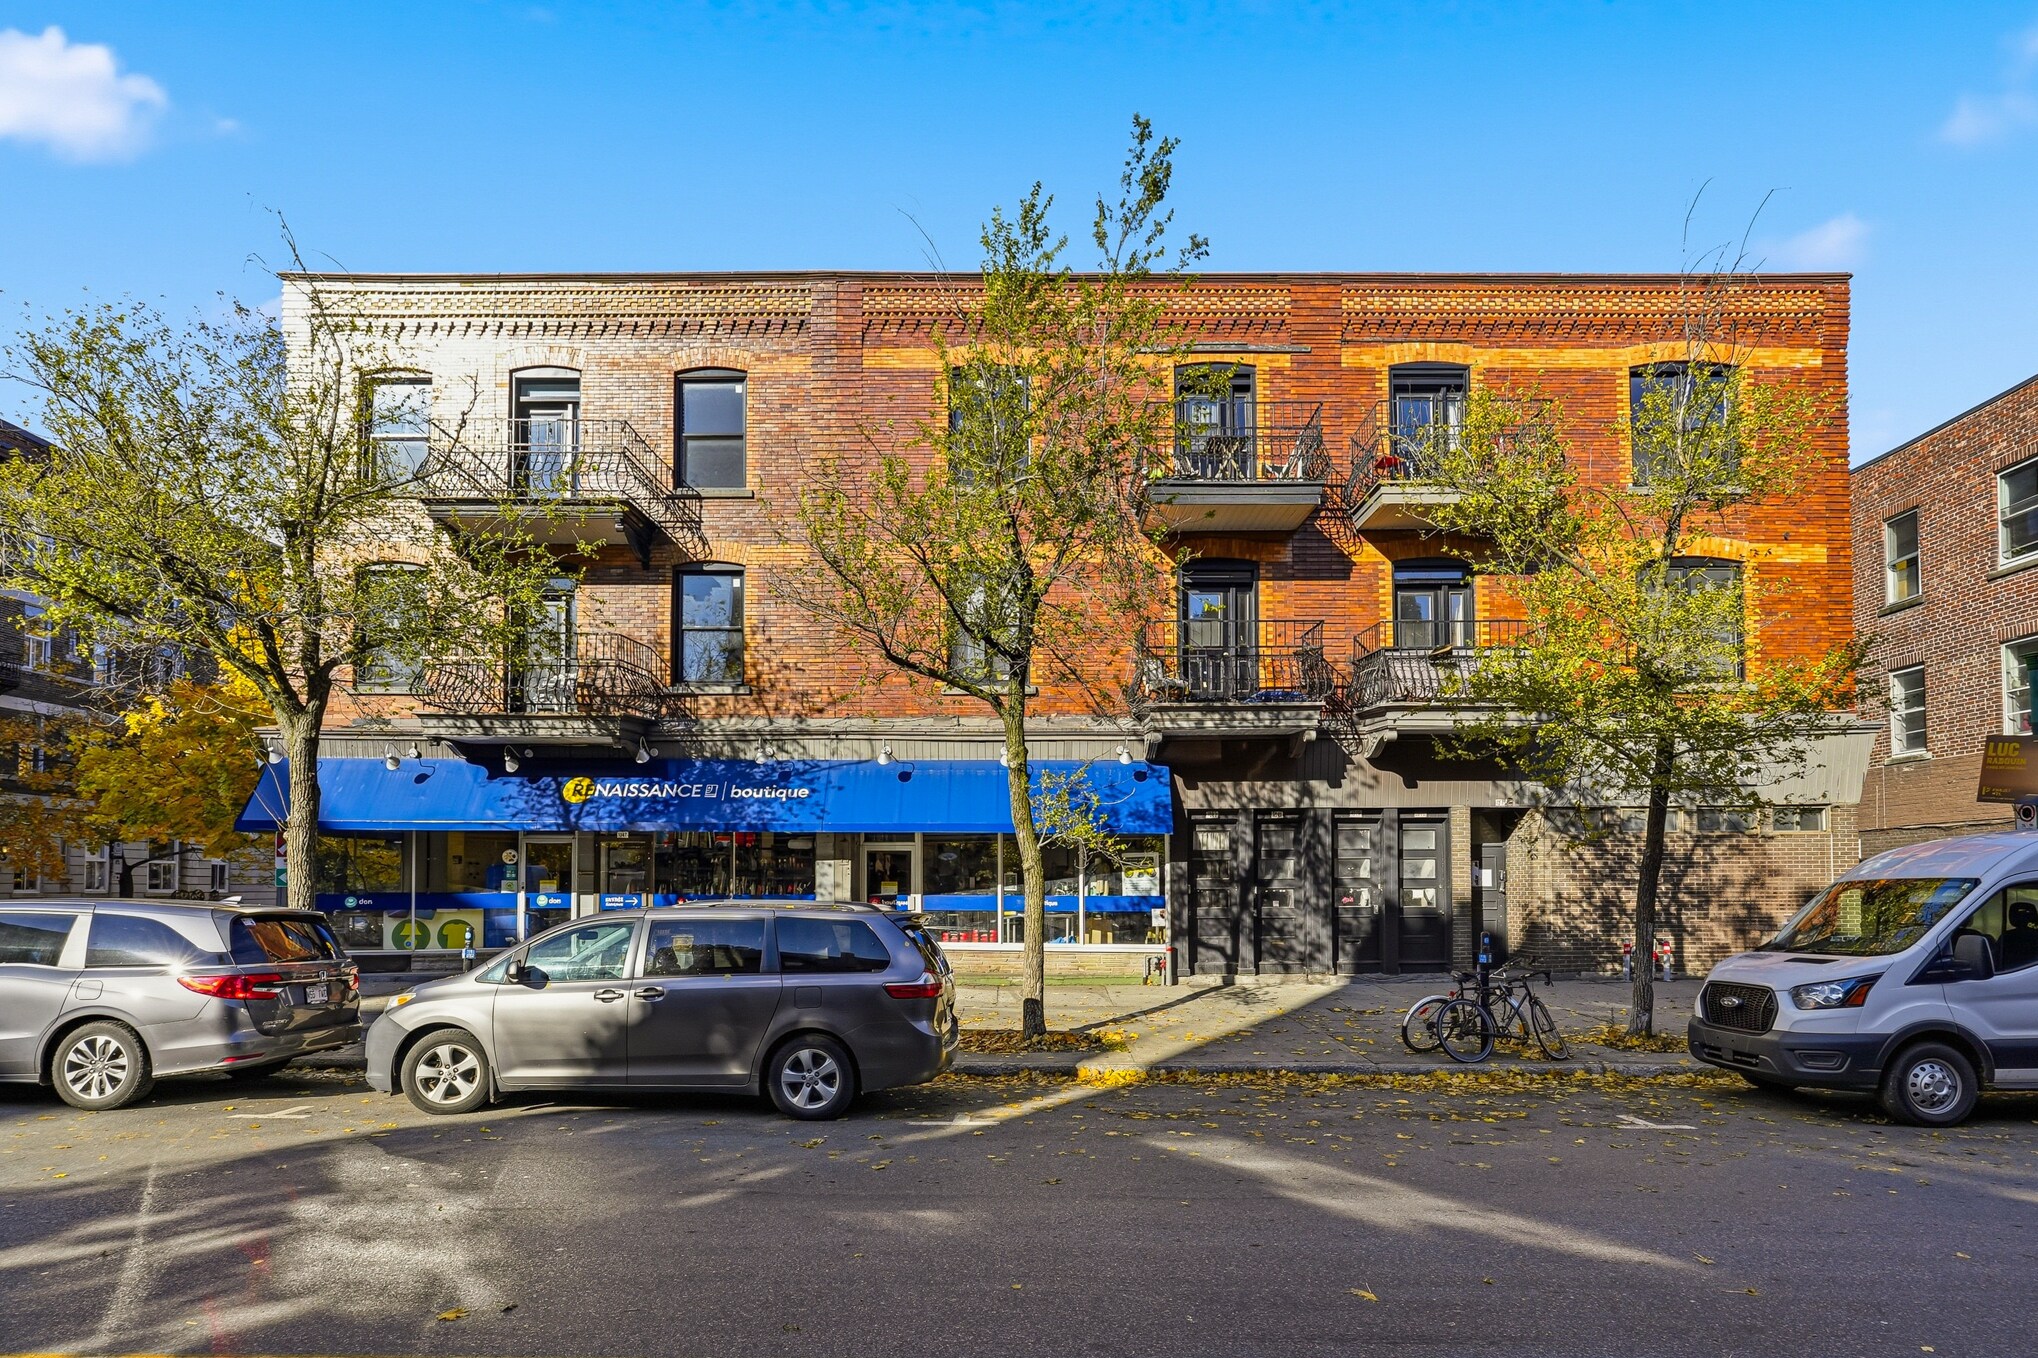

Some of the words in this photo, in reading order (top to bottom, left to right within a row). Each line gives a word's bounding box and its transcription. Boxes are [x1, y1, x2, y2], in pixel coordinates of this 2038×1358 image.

[1988, 742, 2020, 757] LUC
[572, 782, 703, 798] RENAISSANCE
[731, 784, 809, 801] boutique
